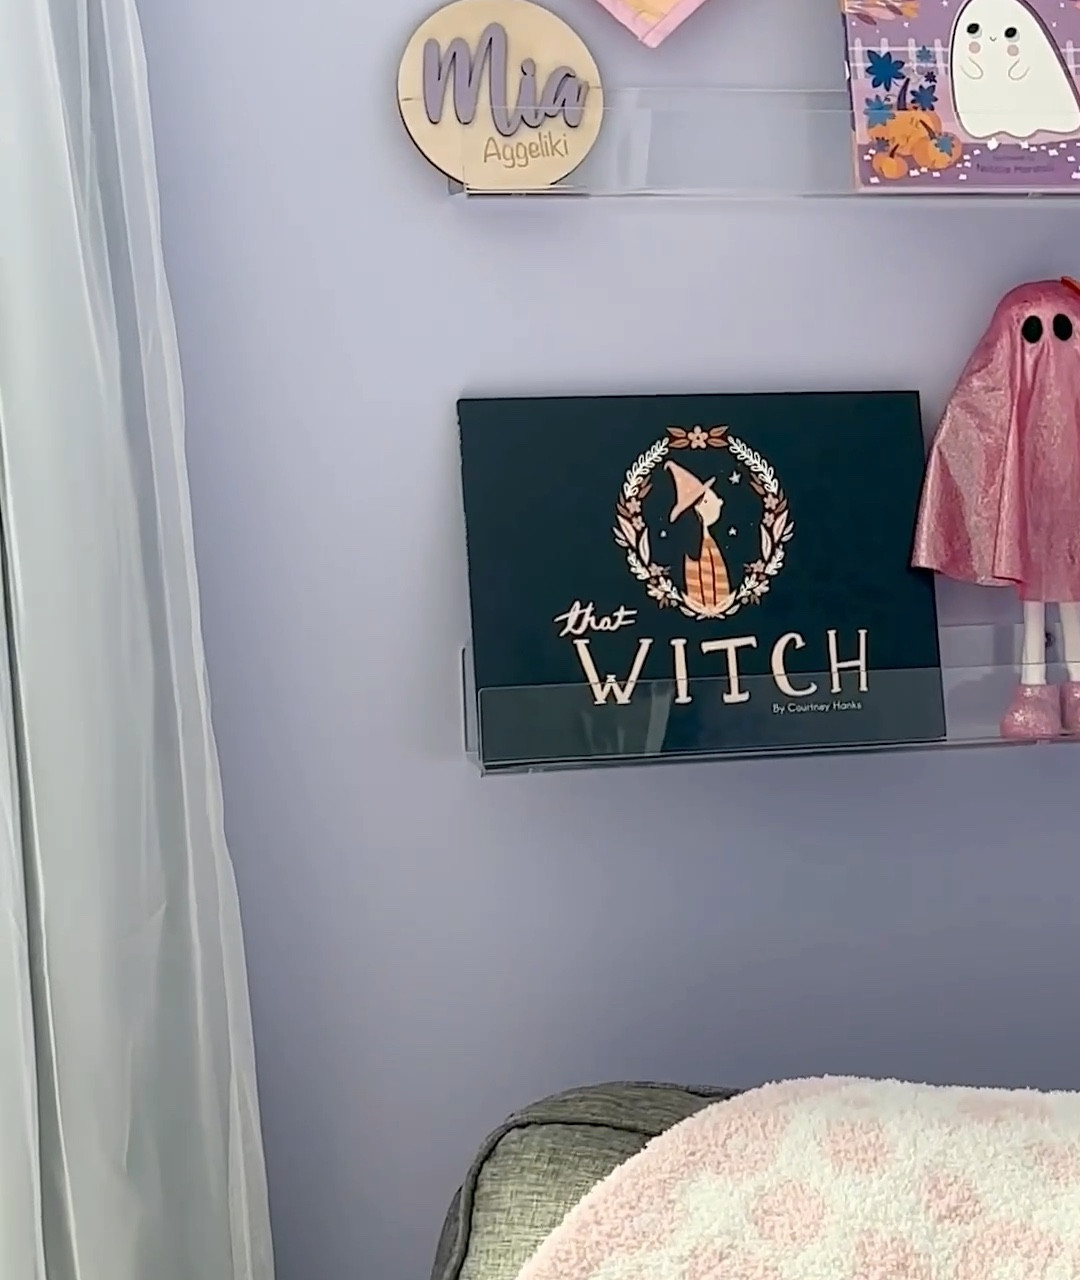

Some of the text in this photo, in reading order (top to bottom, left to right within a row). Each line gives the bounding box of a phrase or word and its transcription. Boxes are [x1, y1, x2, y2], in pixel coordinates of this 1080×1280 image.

[423, 22, 589, 137] Mia
[483, 132, 569, 169] Aggeliki
[553, 600, 638, 637] that
[572, 628, 869, 705] WITCH
[772, 700, 862, 715] By Courtney Hanks
